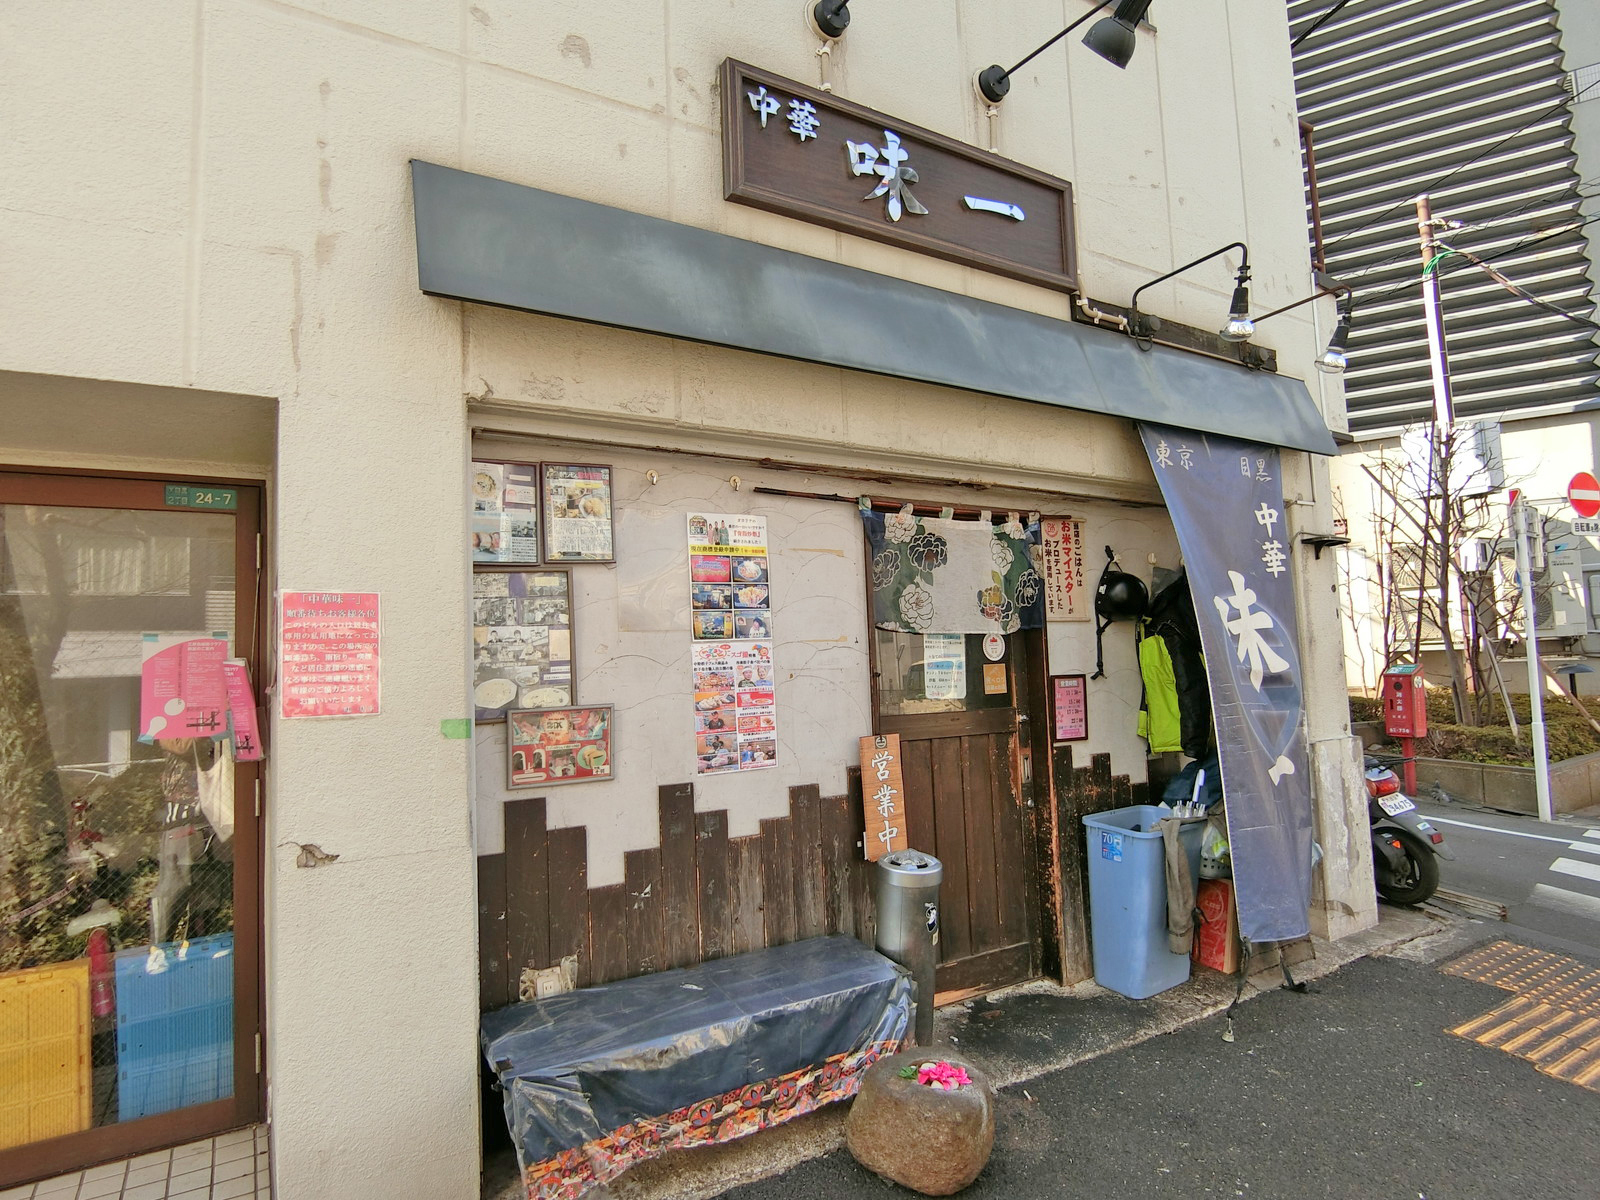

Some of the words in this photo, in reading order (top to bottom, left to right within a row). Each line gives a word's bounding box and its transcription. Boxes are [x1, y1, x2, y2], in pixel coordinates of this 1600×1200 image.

[747, 85, 820, 142] 中華
[846, 129, 1026, 223] 味一
[1155, 439, 1194, 470] 東京
[1240, 456, 1272, 483] 目黒
[195, 492, 232, 505] 24-7
[1053, 540, 1064, 610] プロデュースした
[1061, 520, 1074, 615] お米マイスターが
[1073, 521, 1083, 587] 当店のごはんは
[1254, 502, 1287, 579] 中華
[870, 750, 898, 853] 営業中
